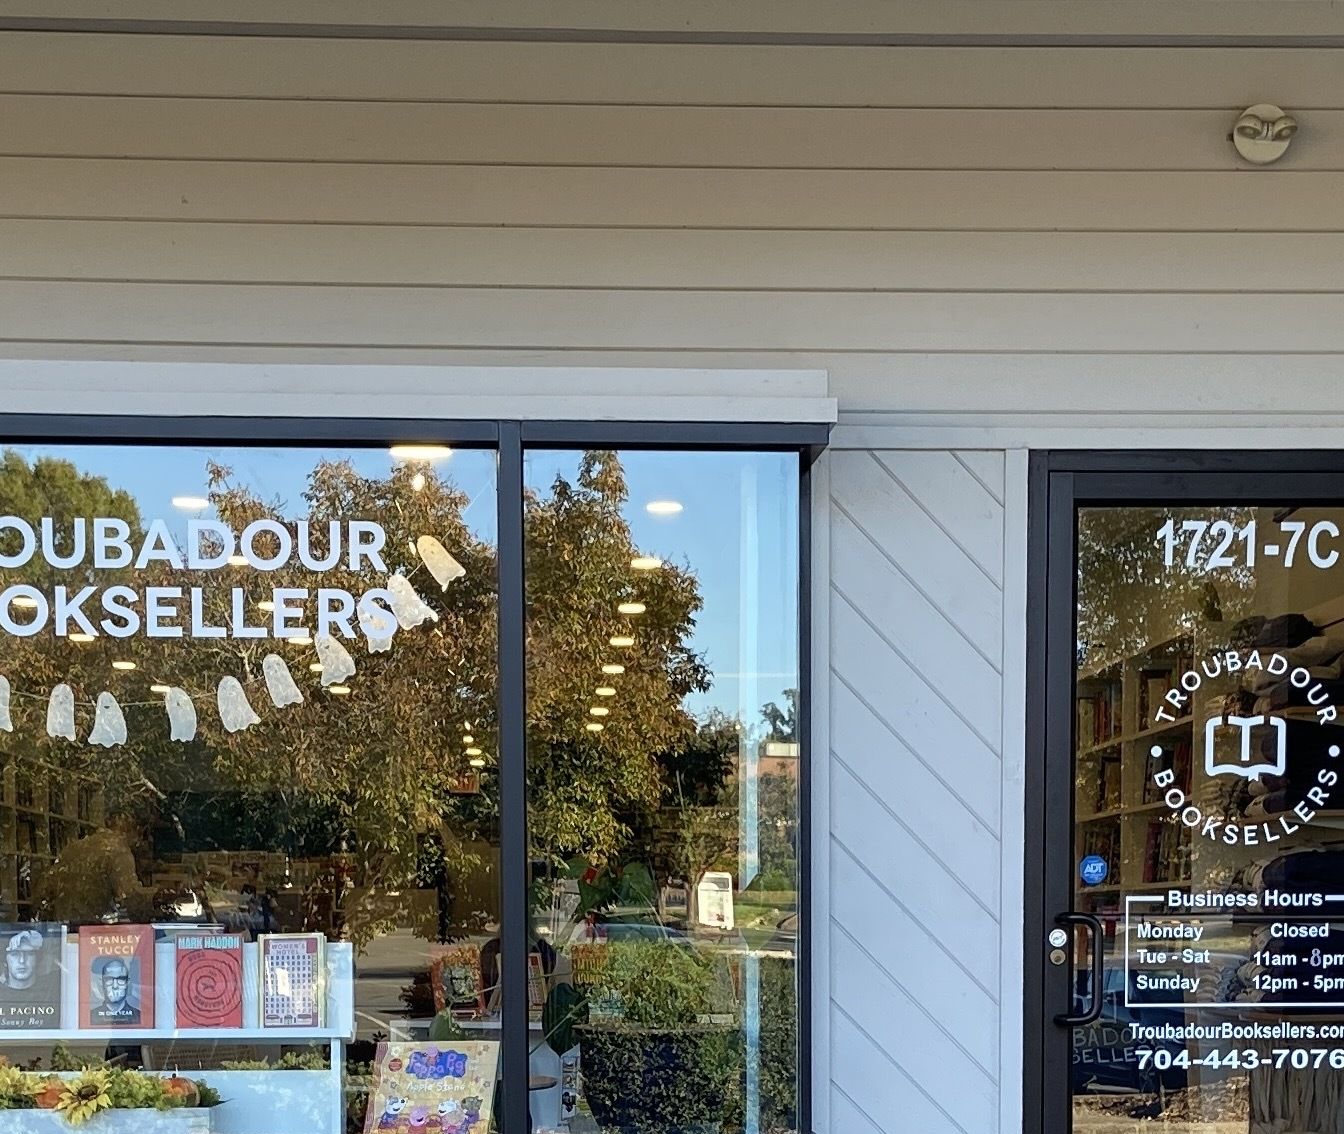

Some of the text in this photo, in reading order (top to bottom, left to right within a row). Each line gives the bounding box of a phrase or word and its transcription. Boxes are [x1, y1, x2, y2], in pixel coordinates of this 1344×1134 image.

[1156, 519, 1340, 571] 1721-7C
[1154, 650, 1338, 725] TROUBADOUR
[1153, 767, 1339, 846] BOOKSELLERS
[1084, 862, 1104, 874] ADT
[1168, 889, 1324, 907] Business Hours
[1136, 922, 1330, 941] Monday Closed
[90, 934, 142, 945] STANLEY
[178, 936, 240, 949] MARK HADDON
[98, 946, 135, 955] TUCCI
[1136, 949, 1167, 964] Tue
[1182, 948, 1210, 964] Sat
[1253, 951, 1298, 966] 11am
[1136, 974, 1201, 993] Sunday
[1252, 975, 1298, 992] 12pm
[10, 1006, 55, 1016] PACINO
[0, 1017, 44, 1027] Sonny Boy
[406, 1082, 433, 1093] Apple
